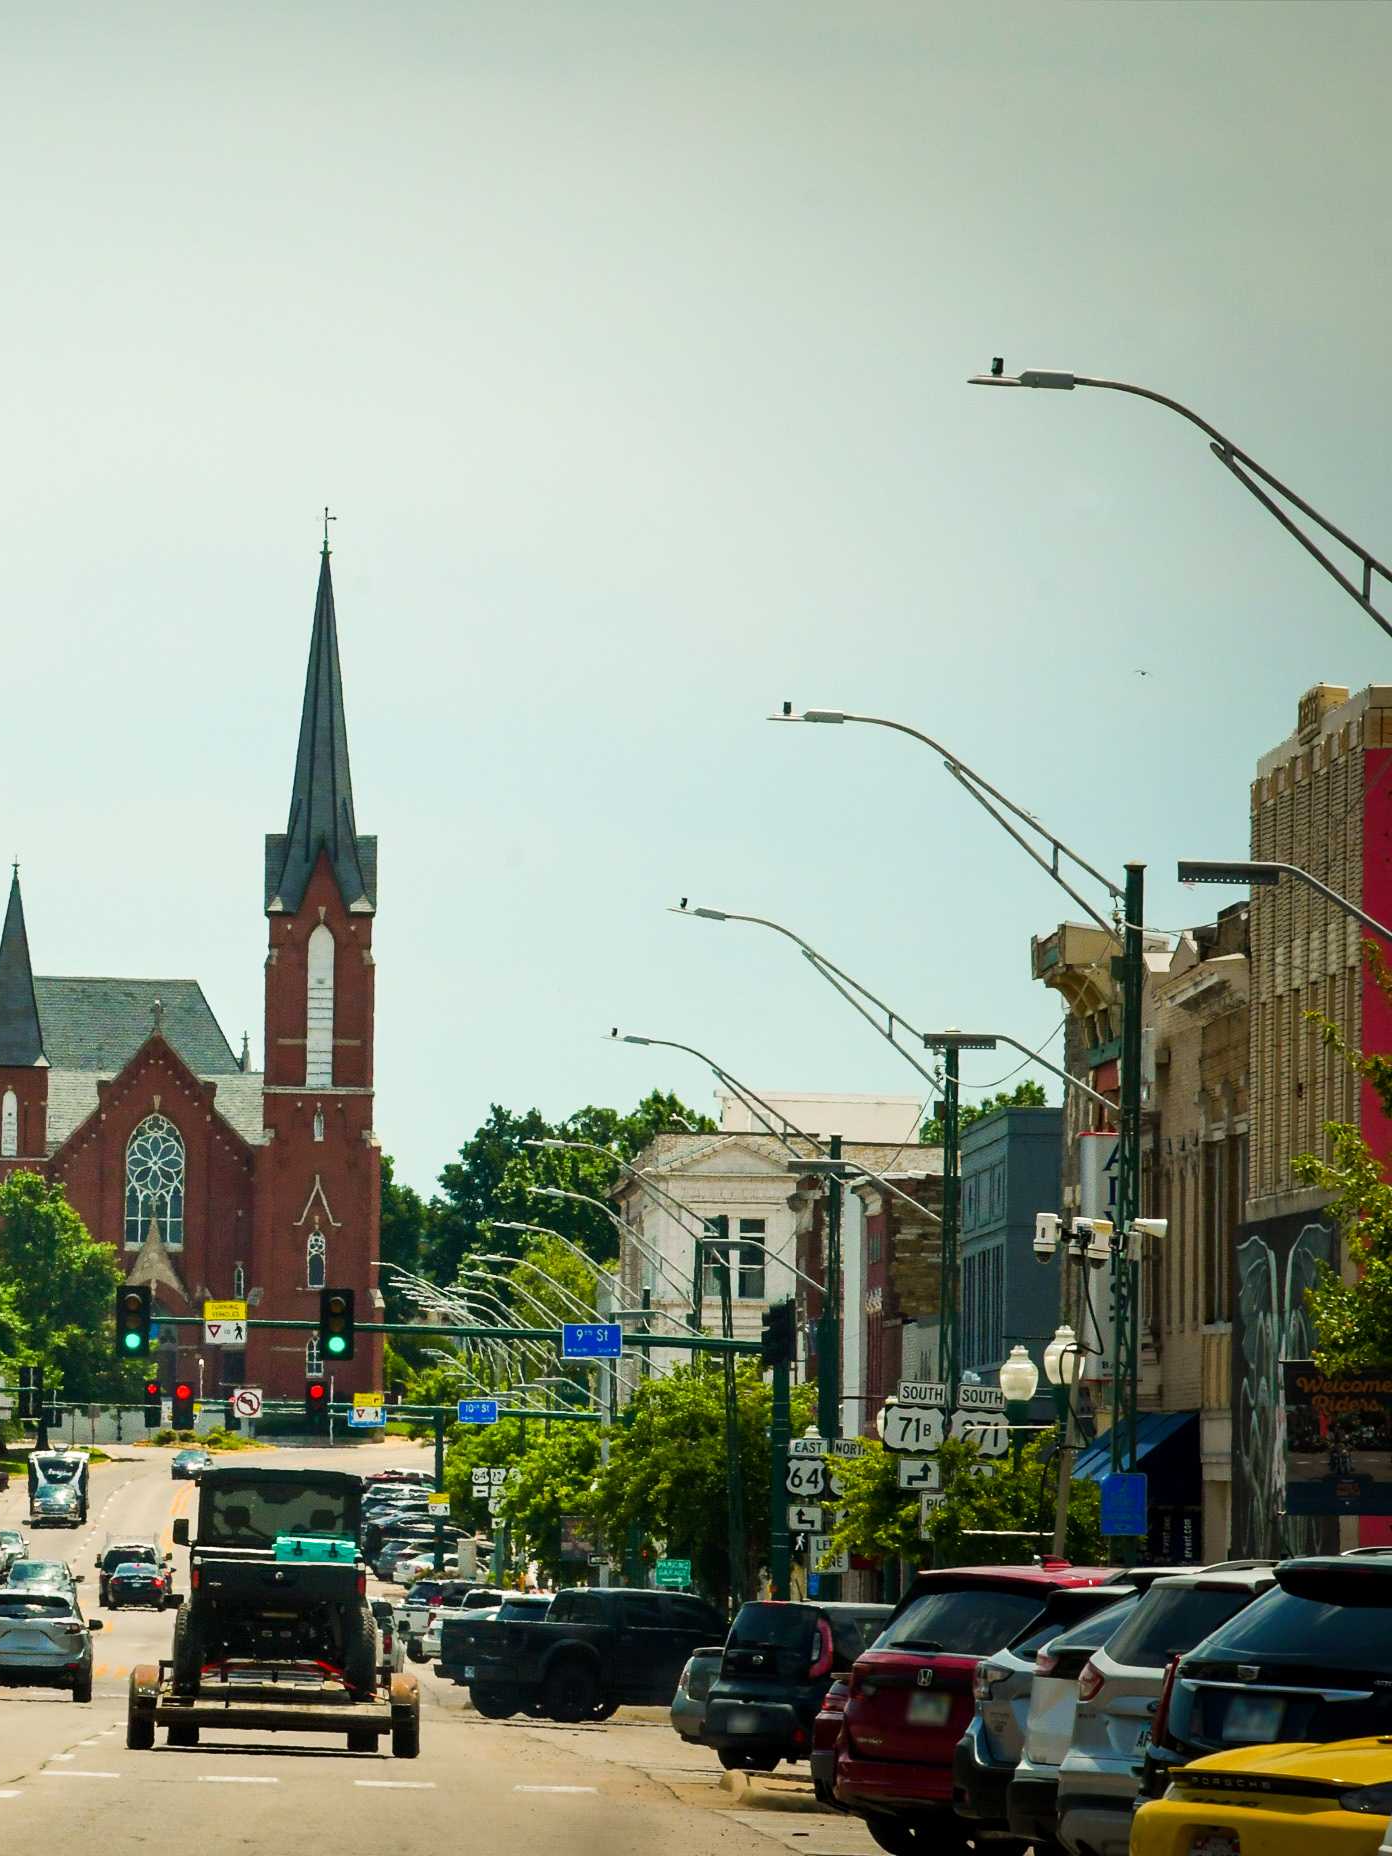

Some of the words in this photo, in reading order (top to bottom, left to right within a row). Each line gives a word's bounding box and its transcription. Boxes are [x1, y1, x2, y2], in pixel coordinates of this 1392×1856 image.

[596, 1328, 609, 1342] St
[1296, 1376, 1392, 1393] Welcome
[902, 1385, 944, 1401] SOUTH
[962, 1389, 1004, 1405] SOUTH
[960, 1419, 999, 1448] 271
[794, 1442, 822, 1454] EAST
[791, 1466, 820, 1490] 64
[927, 1498, 946, 1511] RIG
[1191, 1776, 1272, 1790] PORSCHE
